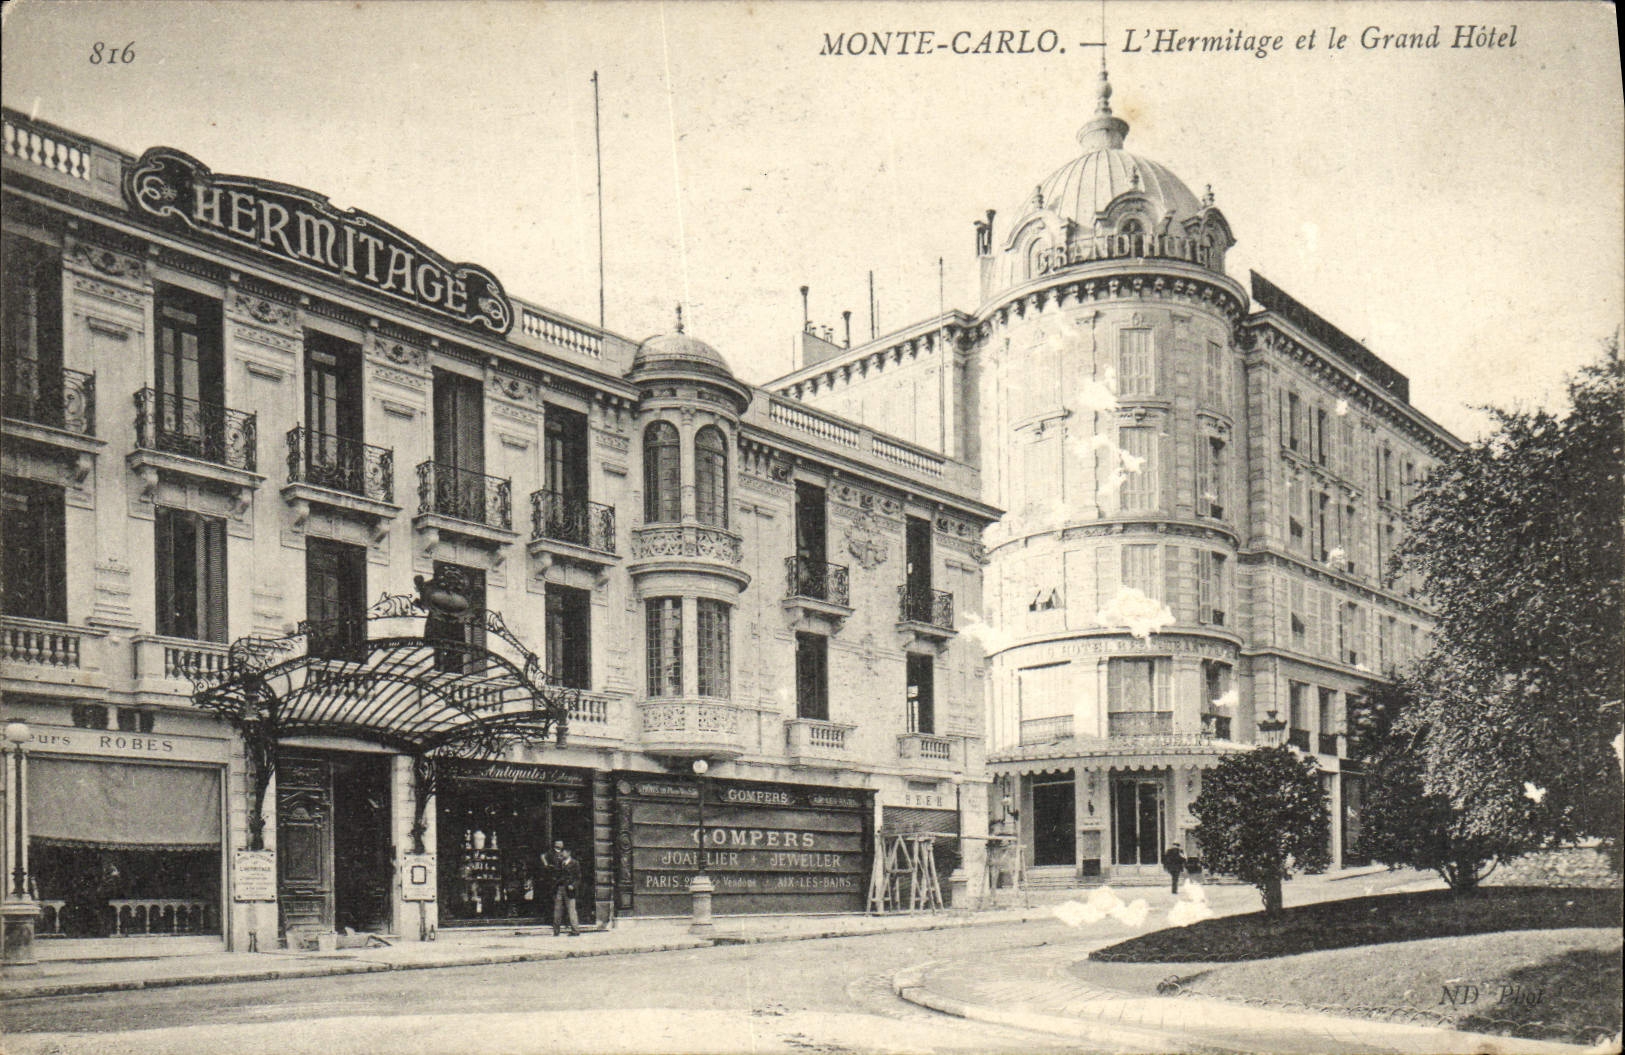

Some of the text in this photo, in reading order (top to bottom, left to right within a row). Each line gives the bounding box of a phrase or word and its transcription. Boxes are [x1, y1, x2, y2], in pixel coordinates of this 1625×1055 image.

[192, 183, 469, 313] HERMITAGE
[1036, 232, 1131, 276] GRAND
[99, 735, 174, 752] ROBES
[727, 788, 789, 804] GOMPERS
[691, 828, 816, 848] GOMPERS
[661, 851, 738, 866] JOAILIER
[769, 852, 841, 868] JEWELLER
[645, 874, 679, 888] PARIS
